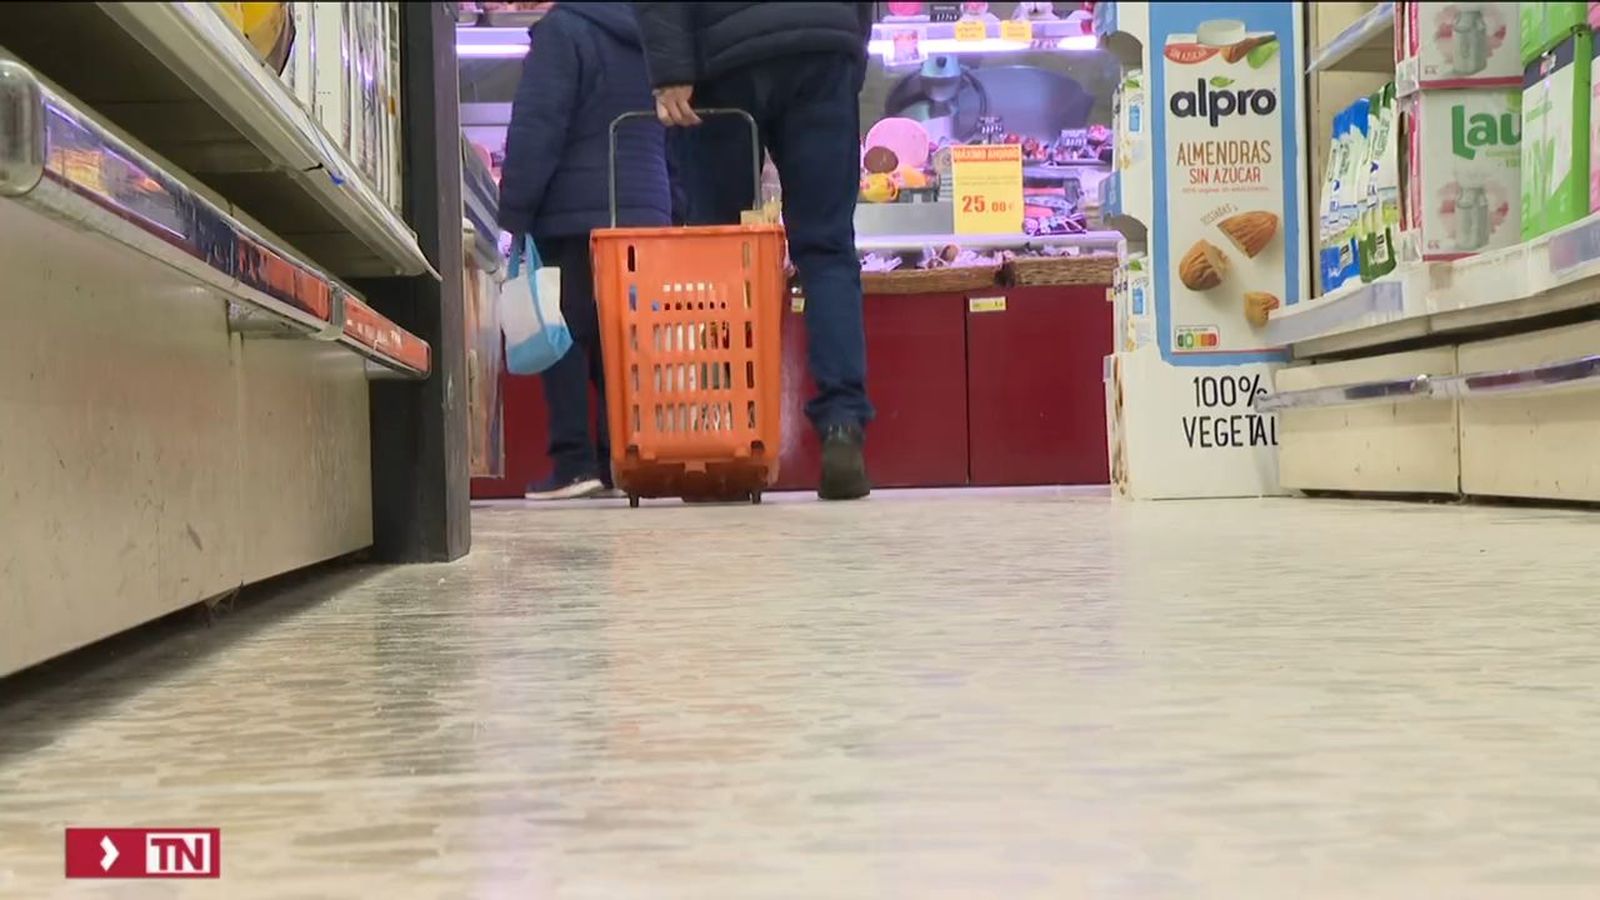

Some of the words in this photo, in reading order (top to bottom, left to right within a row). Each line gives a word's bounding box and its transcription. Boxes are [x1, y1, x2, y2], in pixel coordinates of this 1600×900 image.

[1170, 78, 1277, 127] alpro
[1177, 140, 1272, 166] ALMENDRAS
[1189, 168, 1209, 184] SIN
[1193, 374, 1268, 408] 100%
[1182, 414, 1278, 448] VEGETAL
